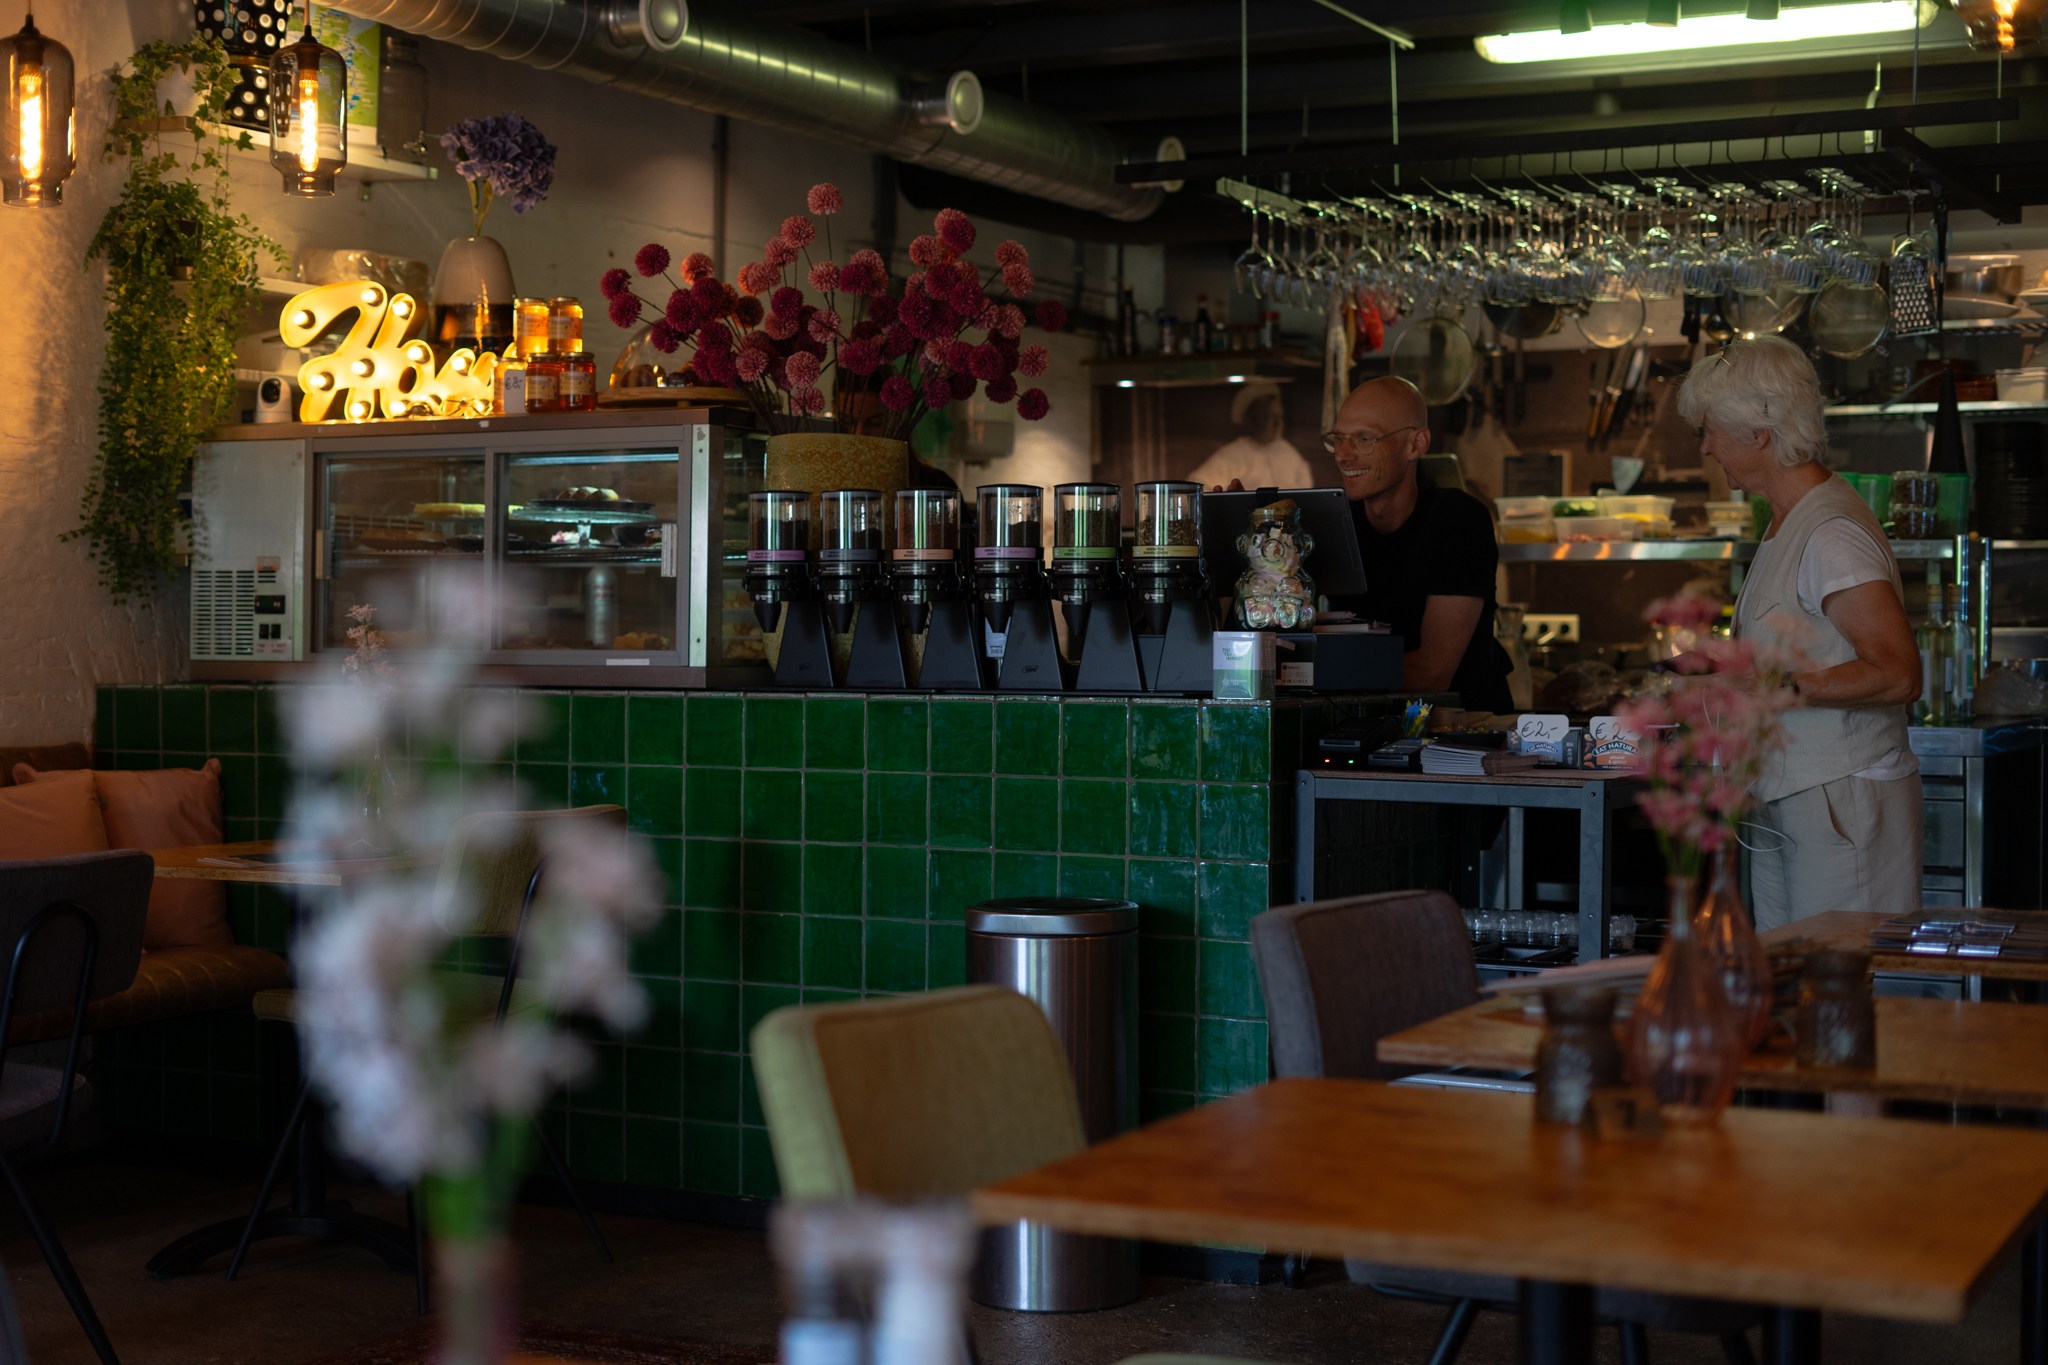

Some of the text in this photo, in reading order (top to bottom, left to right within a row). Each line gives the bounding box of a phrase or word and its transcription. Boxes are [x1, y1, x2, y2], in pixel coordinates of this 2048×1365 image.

[1522, 721, 1558, 739] €2,-
[1595, 742, 1638, 755] EAT NATURA
